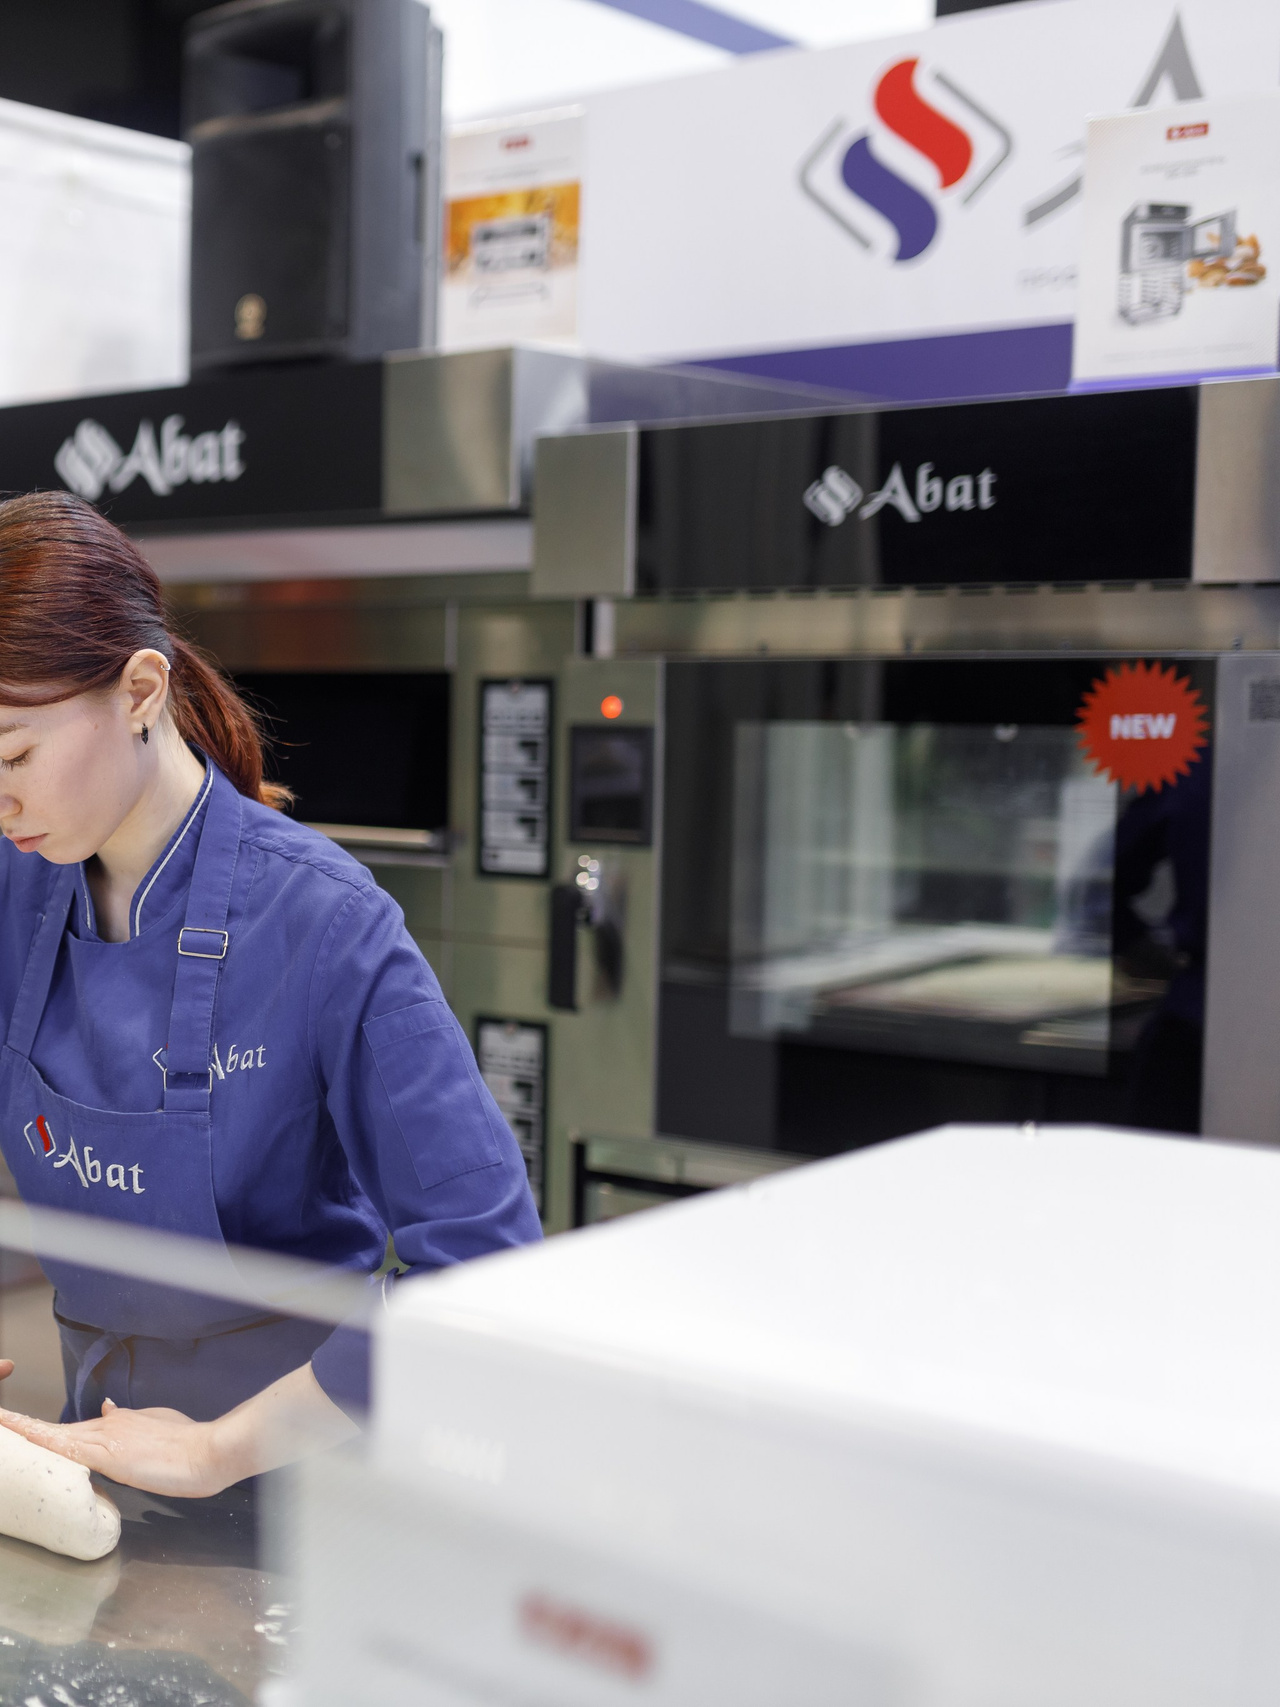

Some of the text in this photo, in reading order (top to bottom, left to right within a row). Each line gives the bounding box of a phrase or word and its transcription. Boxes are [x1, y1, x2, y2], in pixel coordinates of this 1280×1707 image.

[108, 413, 247, 496] Abat
[858, 461, 998, 523] Abat
[1109, 712, 1178, 740] NEW
[53, 1135, 146, 1194] Abat
